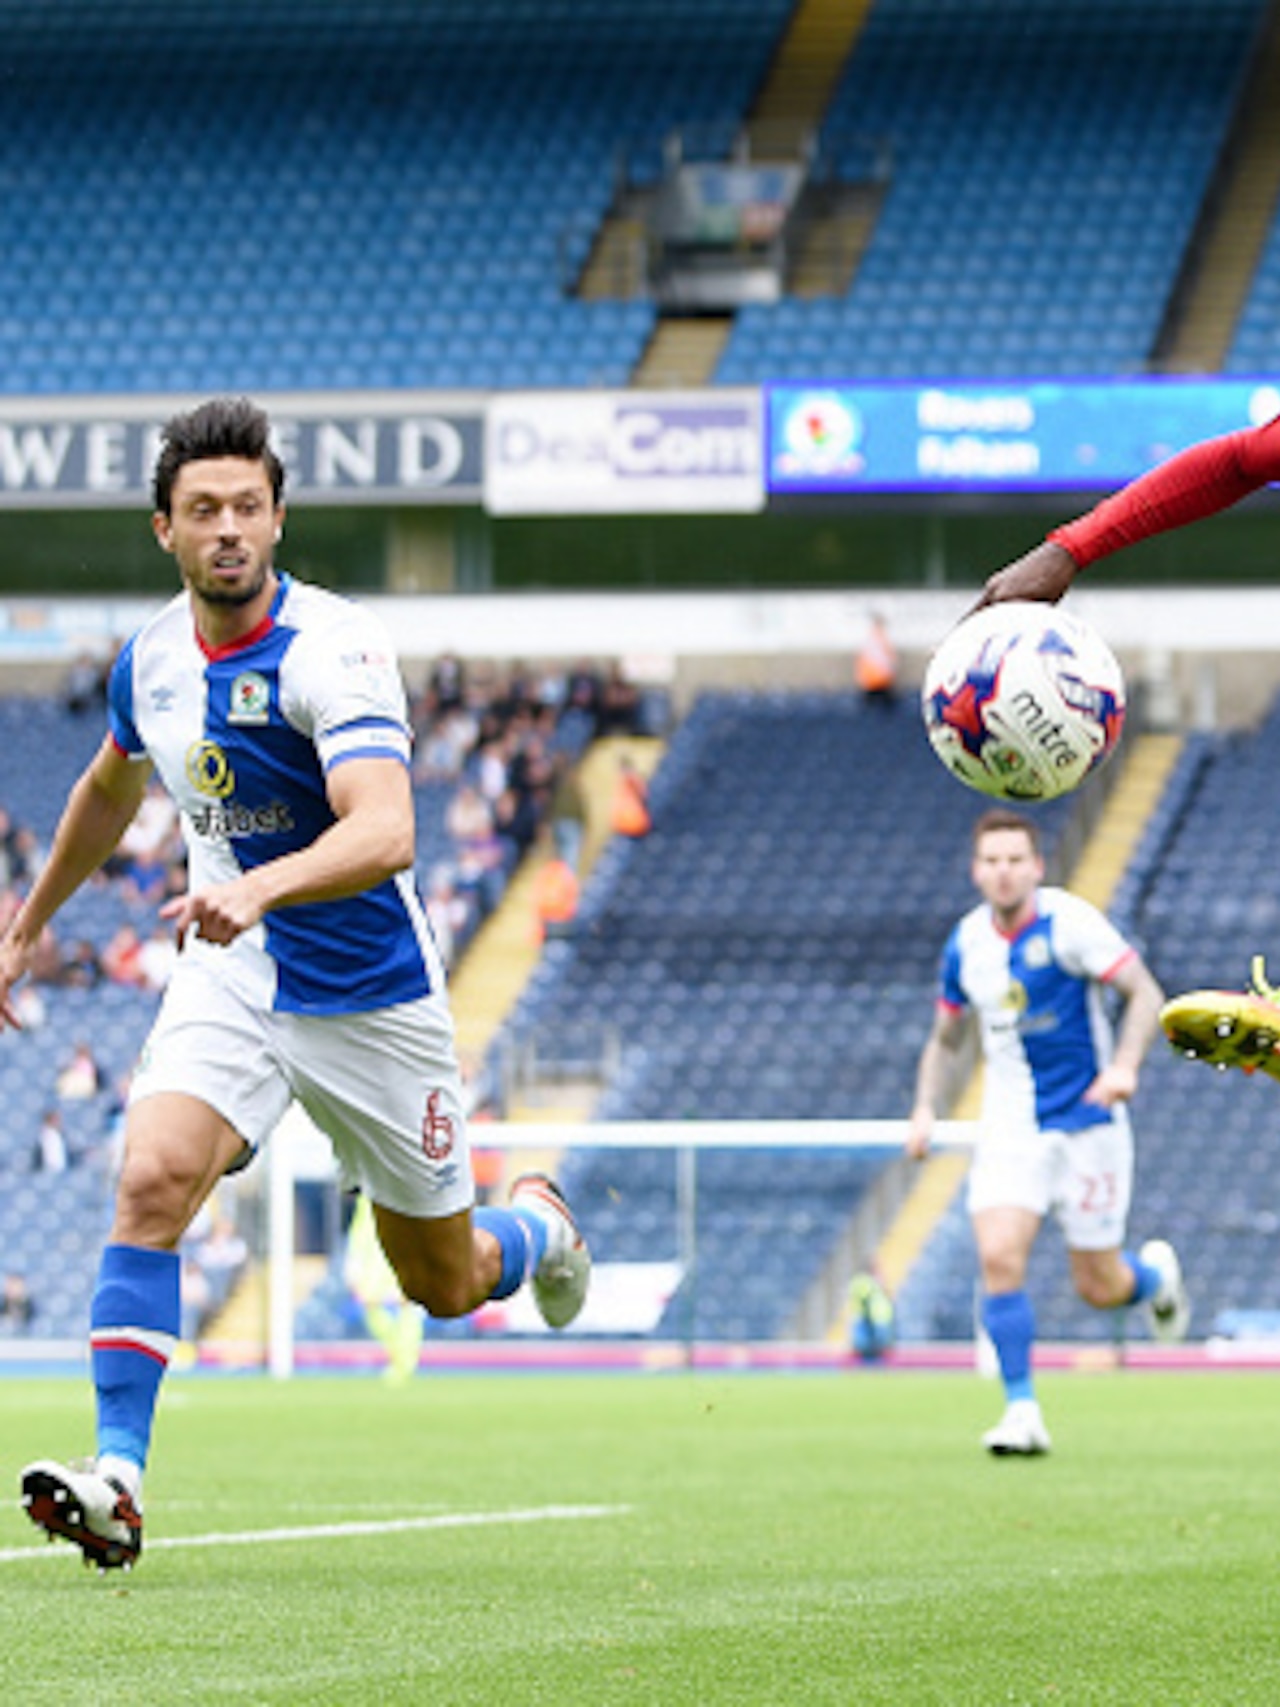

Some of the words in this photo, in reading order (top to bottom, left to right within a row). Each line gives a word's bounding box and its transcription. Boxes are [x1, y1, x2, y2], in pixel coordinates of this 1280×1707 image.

[0, 417, 464, 487] WEEND
[1012, 690, 1078, 768] mitre
[422, 1086, 455, 1160] 6
